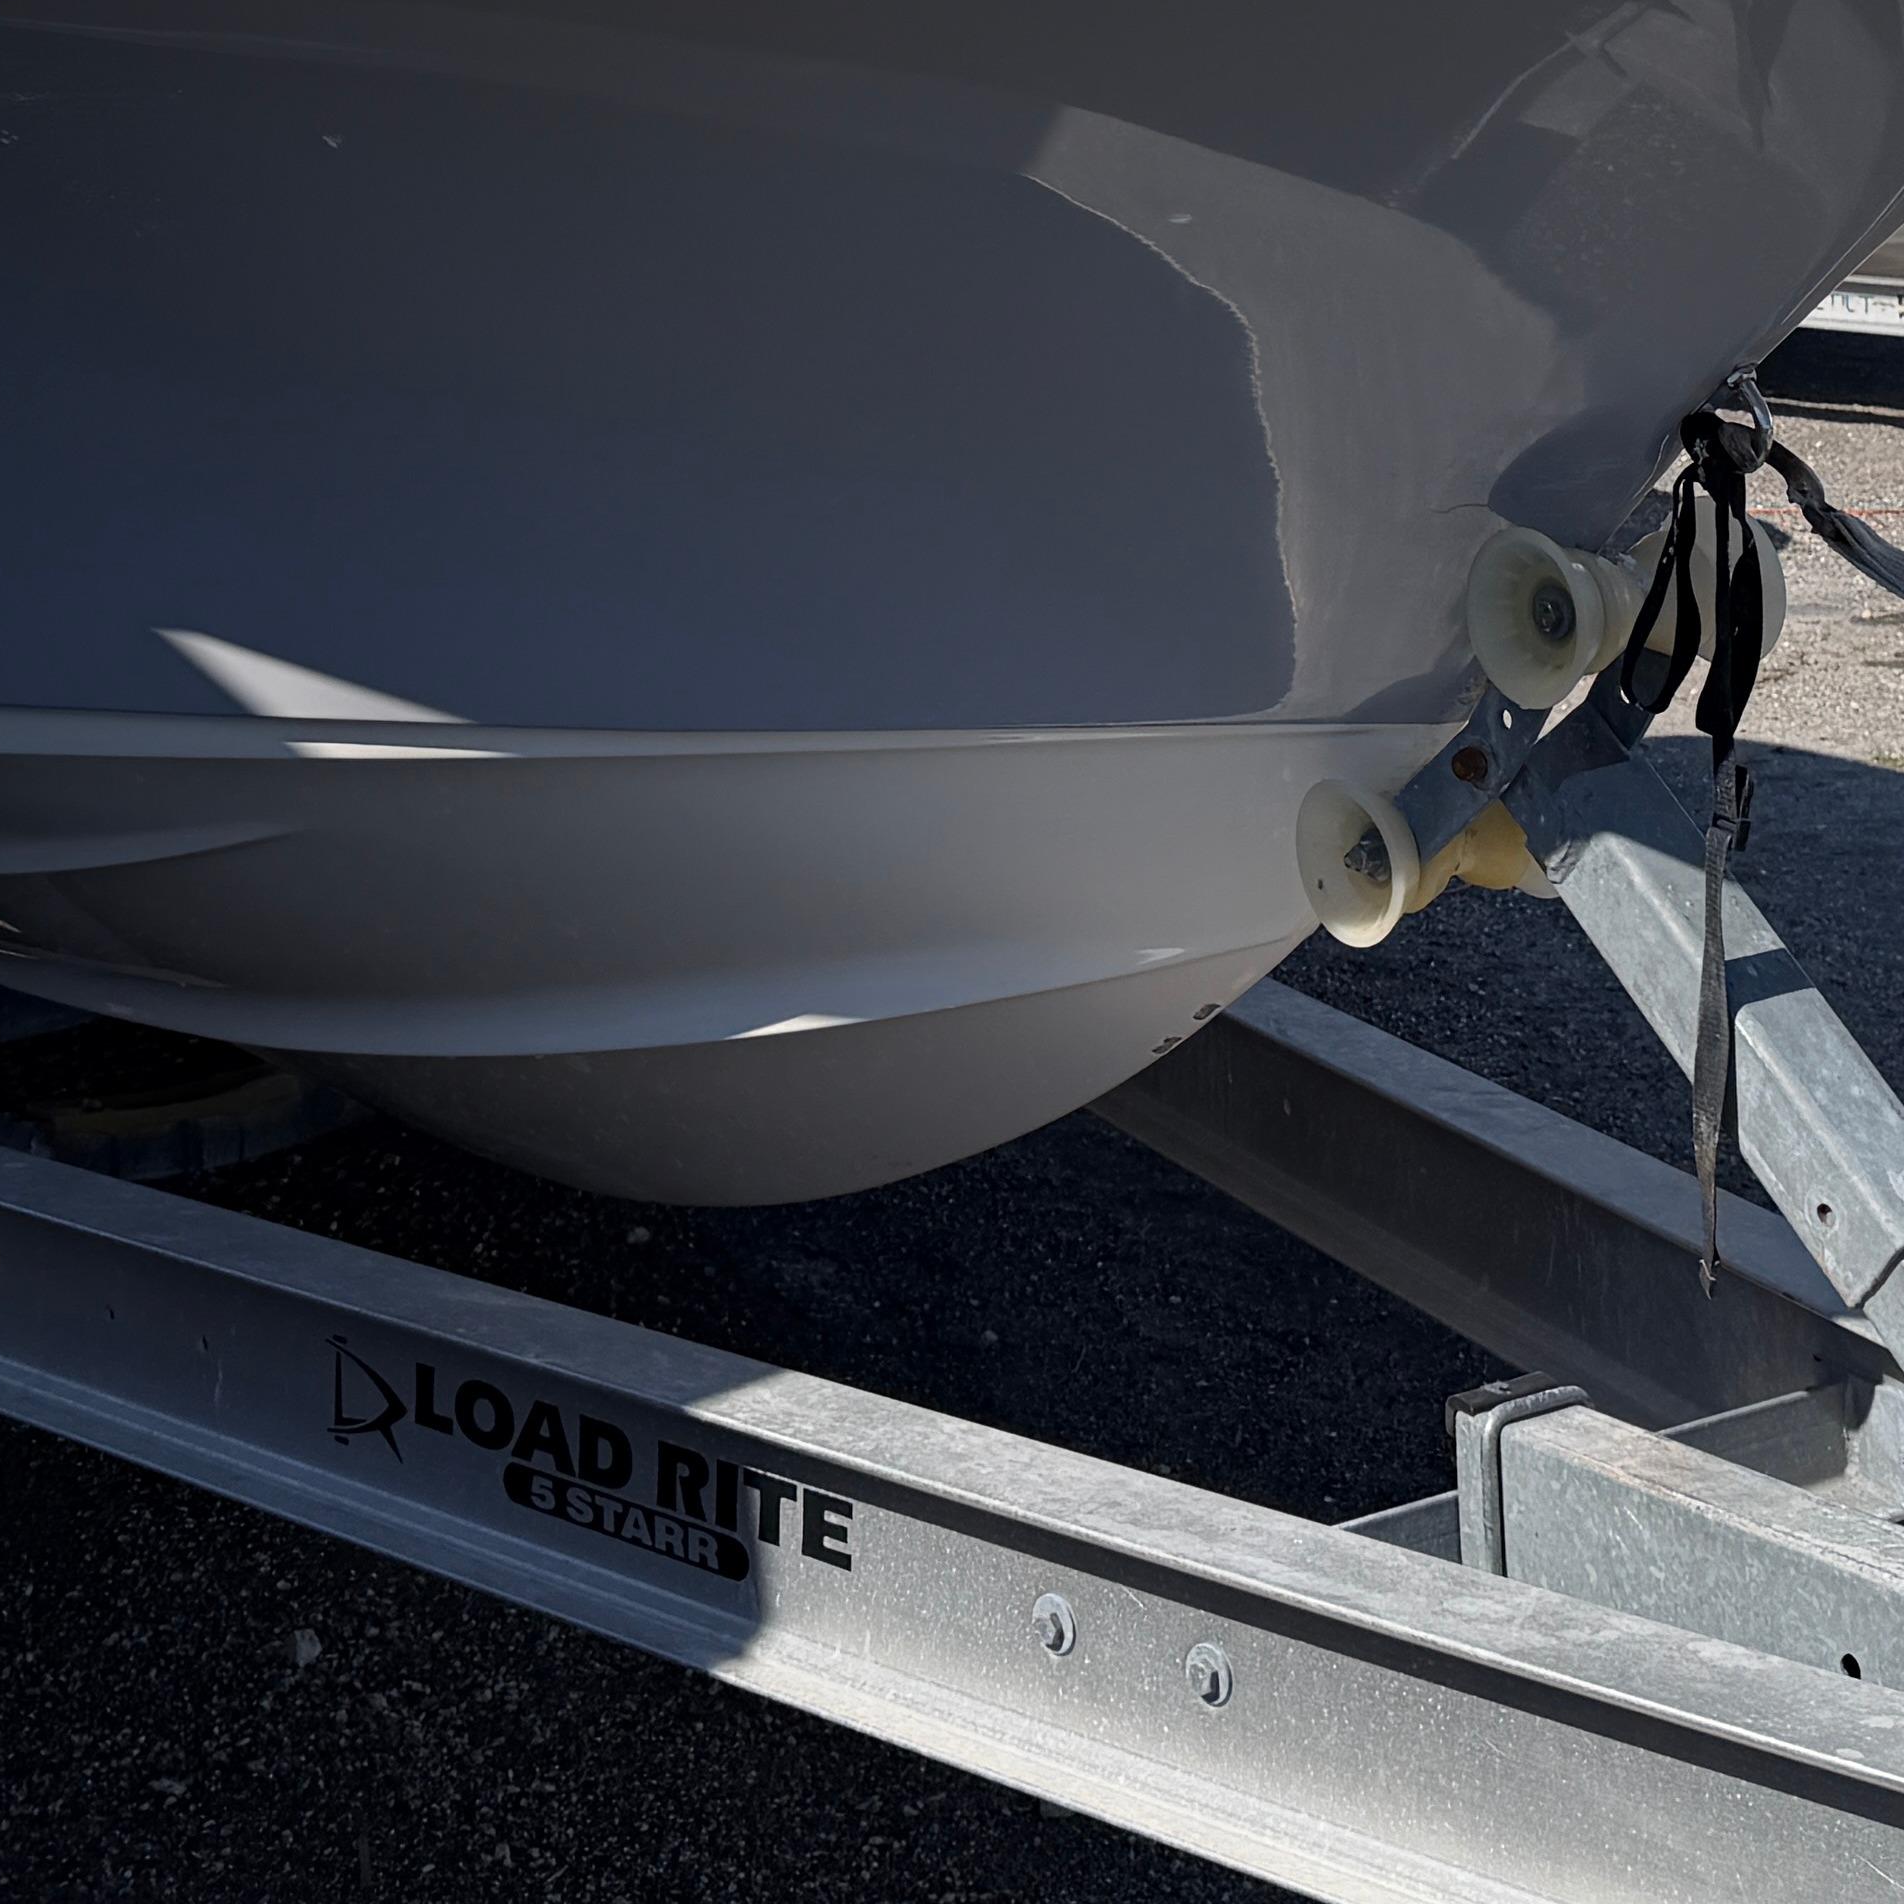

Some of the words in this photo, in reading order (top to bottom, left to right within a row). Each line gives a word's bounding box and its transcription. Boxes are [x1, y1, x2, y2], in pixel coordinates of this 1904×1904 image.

[414, 1361, 633, 1490] LOAD
[656, 1439, 854, 1573] RITE
[529, 1474, 556, 1511] 5
[565, 1485, 720, 1570] STARR
